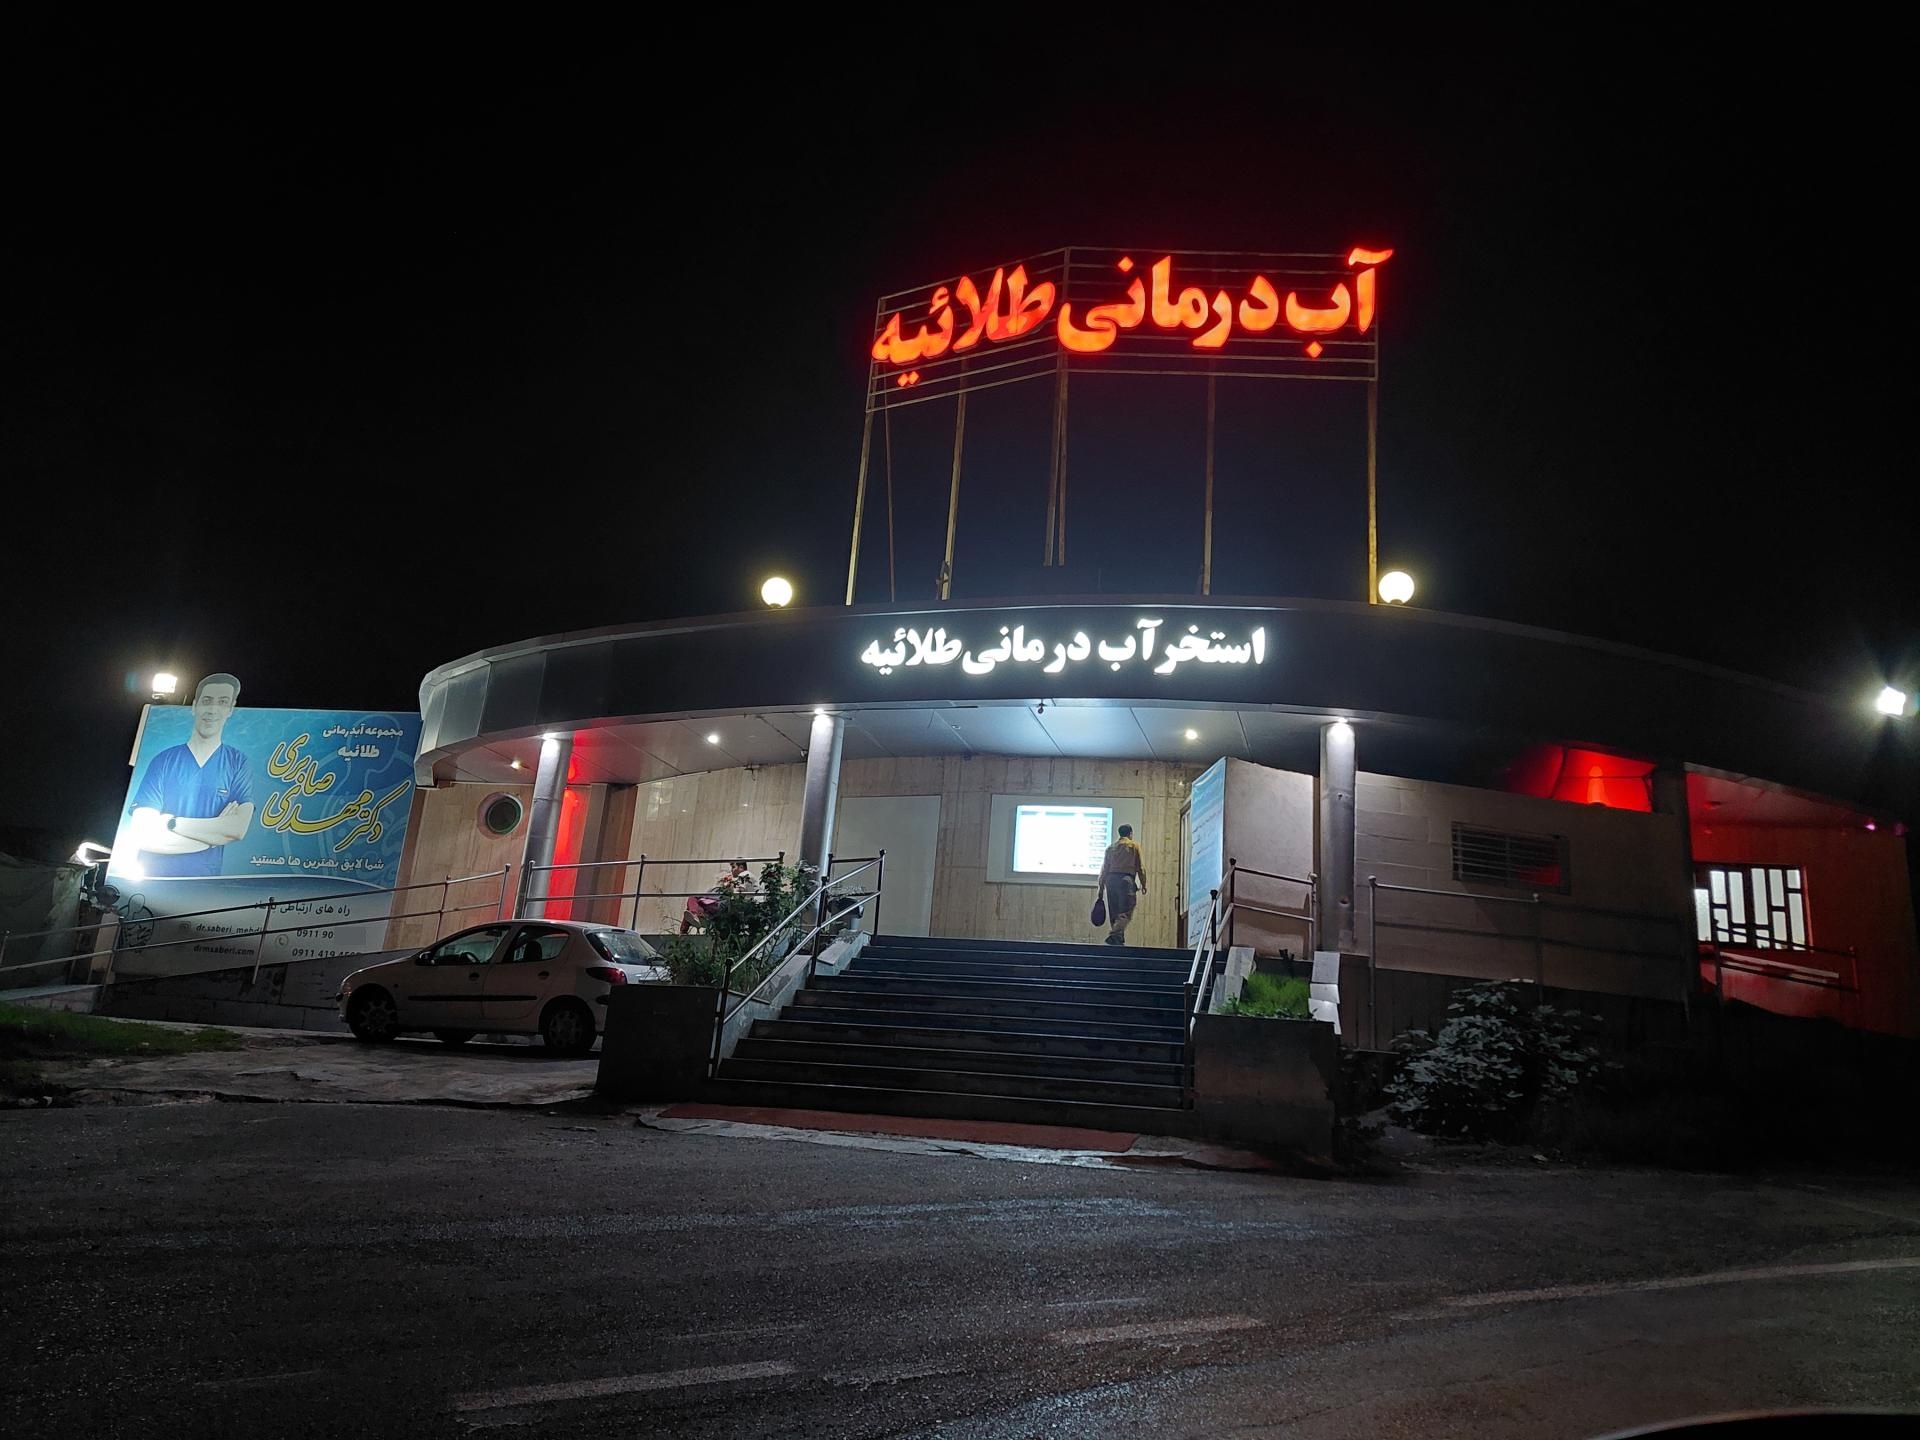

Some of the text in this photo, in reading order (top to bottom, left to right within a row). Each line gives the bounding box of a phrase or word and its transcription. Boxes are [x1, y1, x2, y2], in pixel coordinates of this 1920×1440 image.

[861, 626, 963, 676] طلائیه
[1153, 624, 1266, 676] استخر
[365, 726, 404, 738] مجموعه
[268, 733, 335, 796] صابری
[261, 780, 411, 852] دکتر مهدی
[250, 855, 385, 871] شما لایق بهترین ها هستید
[280, 902, 313, 915] ارتباطی
[315, 903, 334, 915] های
[338, 904, 351, 916] راه
[296, 929, 319, 938] 0911
[292, 948, 315, 957] 0911
